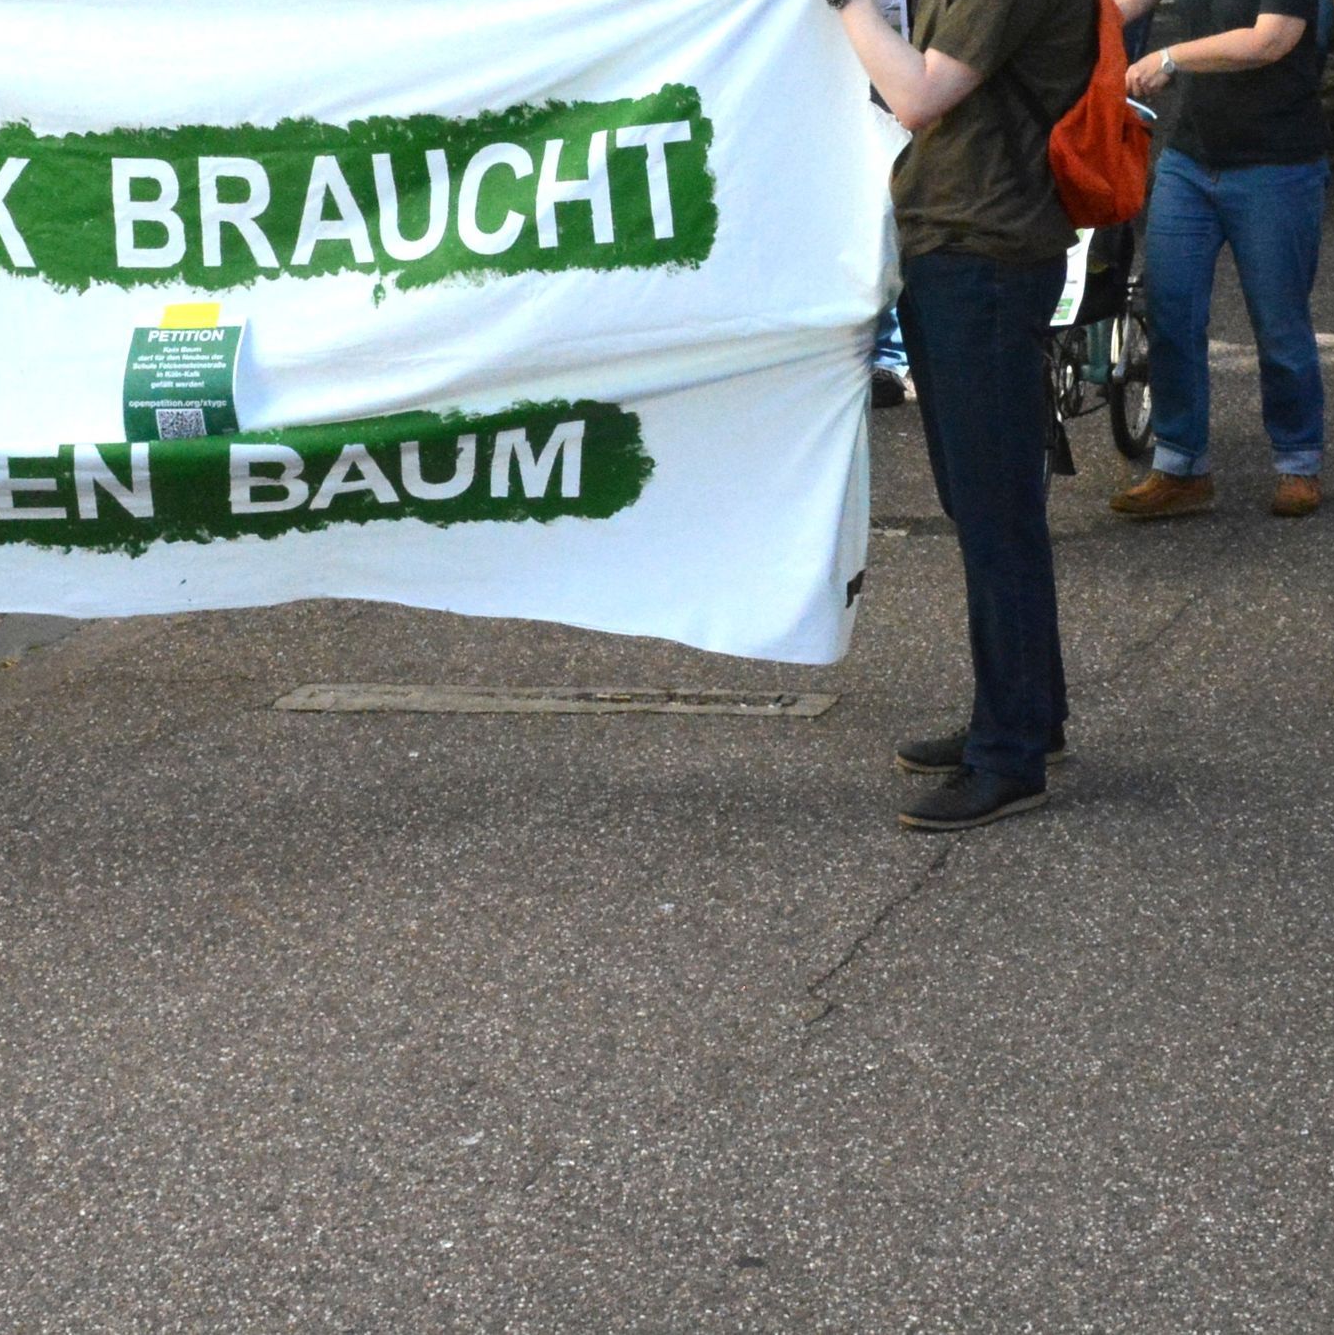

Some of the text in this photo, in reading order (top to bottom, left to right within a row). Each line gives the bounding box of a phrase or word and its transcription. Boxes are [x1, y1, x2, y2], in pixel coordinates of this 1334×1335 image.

[112, 120, 692, 268] BRAUCHT
[147, 330, 225, 342] PETITION
[228, 420, 586, 514] BAUM
